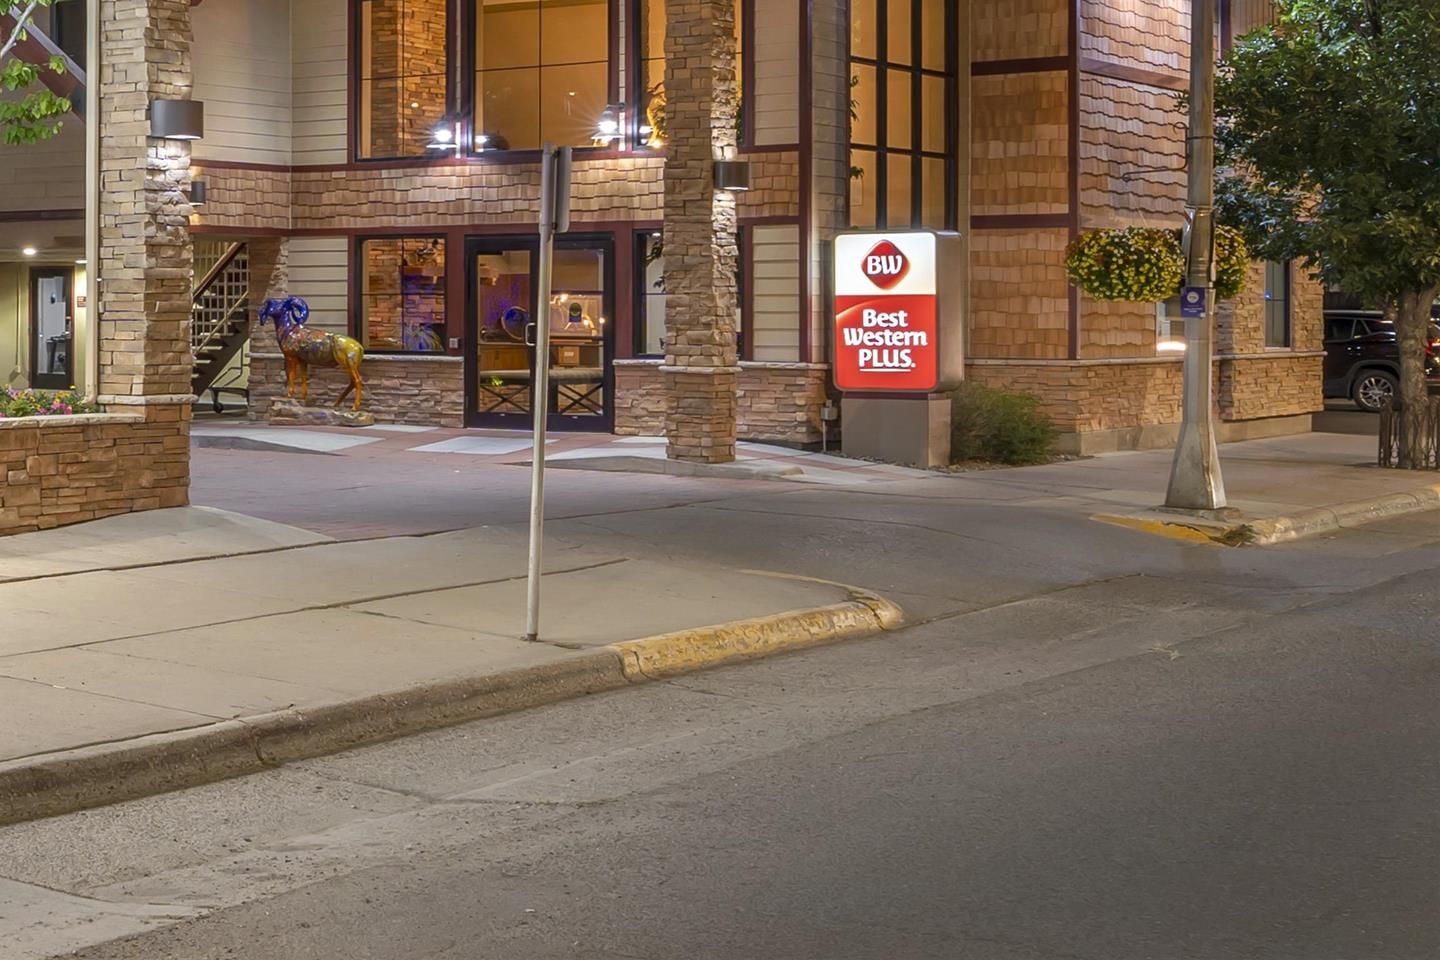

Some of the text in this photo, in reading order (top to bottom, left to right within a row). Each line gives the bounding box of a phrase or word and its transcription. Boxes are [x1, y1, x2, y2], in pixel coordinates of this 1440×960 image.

[867, 255, 903, 275] BW
[862, 308, 909, 328] Best
[842, 327, 929, 346] Western
